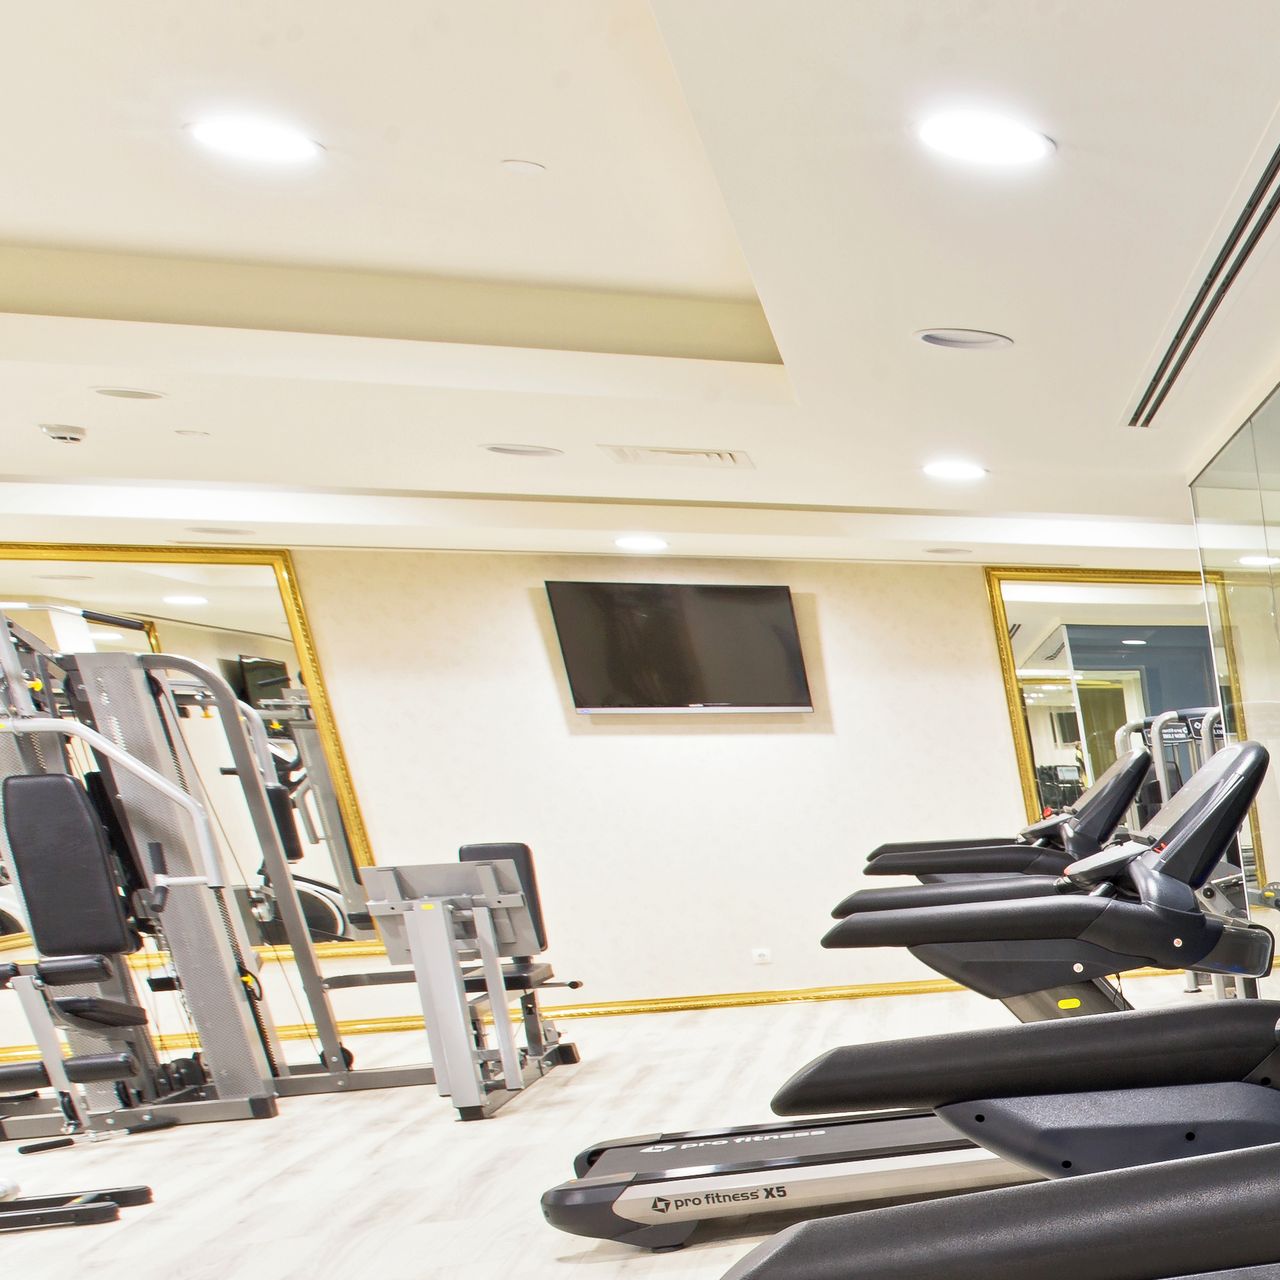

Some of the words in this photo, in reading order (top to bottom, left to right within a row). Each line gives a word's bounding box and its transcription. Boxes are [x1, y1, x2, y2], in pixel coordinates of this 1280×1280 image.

[680, 1140, 728, 1150] pro
[734, 1129, 826, 1144] fitness
[674, 1196, 702, 1210] pro
[704, 1190, 759, 1205] fitness
[763, 1185, 787, 1199] X5
